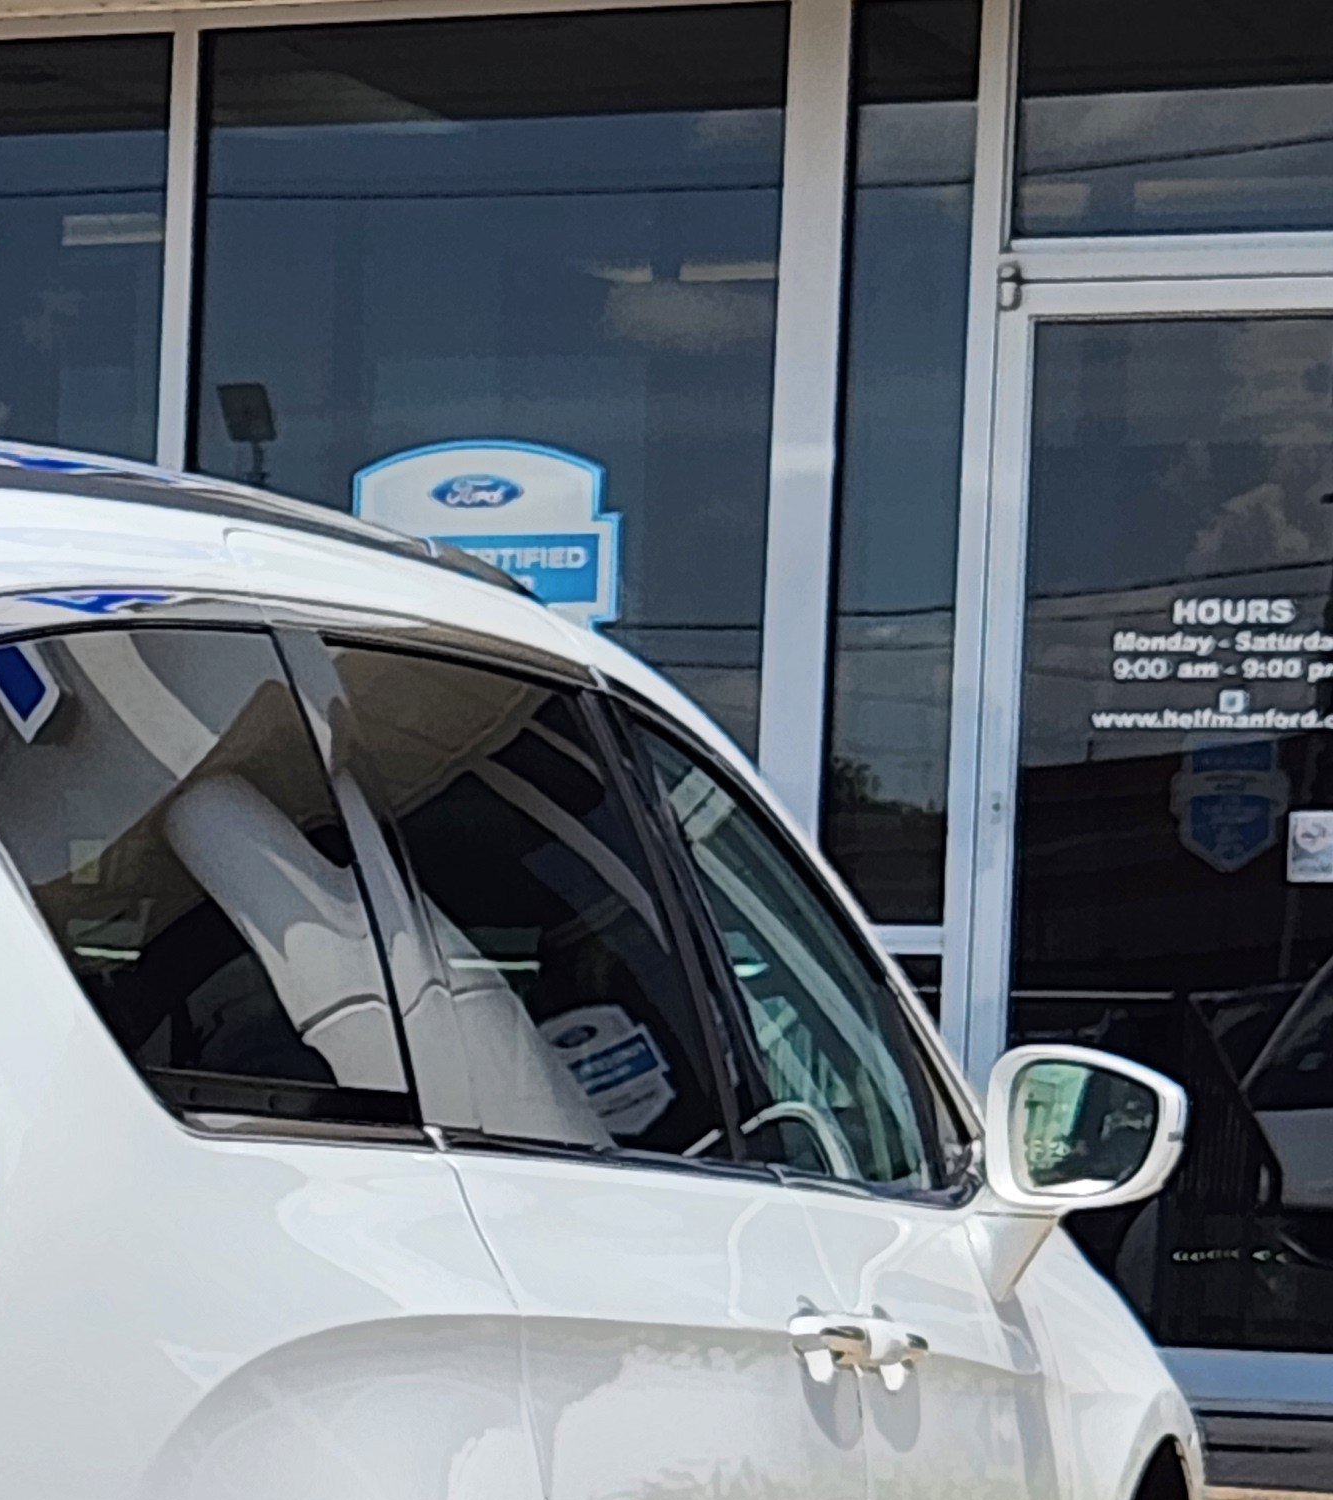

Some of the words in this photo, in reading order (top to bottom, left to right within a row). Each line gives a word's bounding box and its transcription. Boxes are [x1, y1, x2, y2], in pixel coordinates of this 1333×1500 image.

[446, 479, 507, 504] Ford
[1173, 598, 1296, 624] HOURS
[1113, 631, 1216, 656] Monday
[1235, 630, 1333, 652] Saturda
[1113, 657, 1169, 679] 9:00
[1177, 661, 1219, 679] am
[1241, 658, 1303, 678] 9:00
[1091, 707, 1333, 730] www.helfmanford.c
